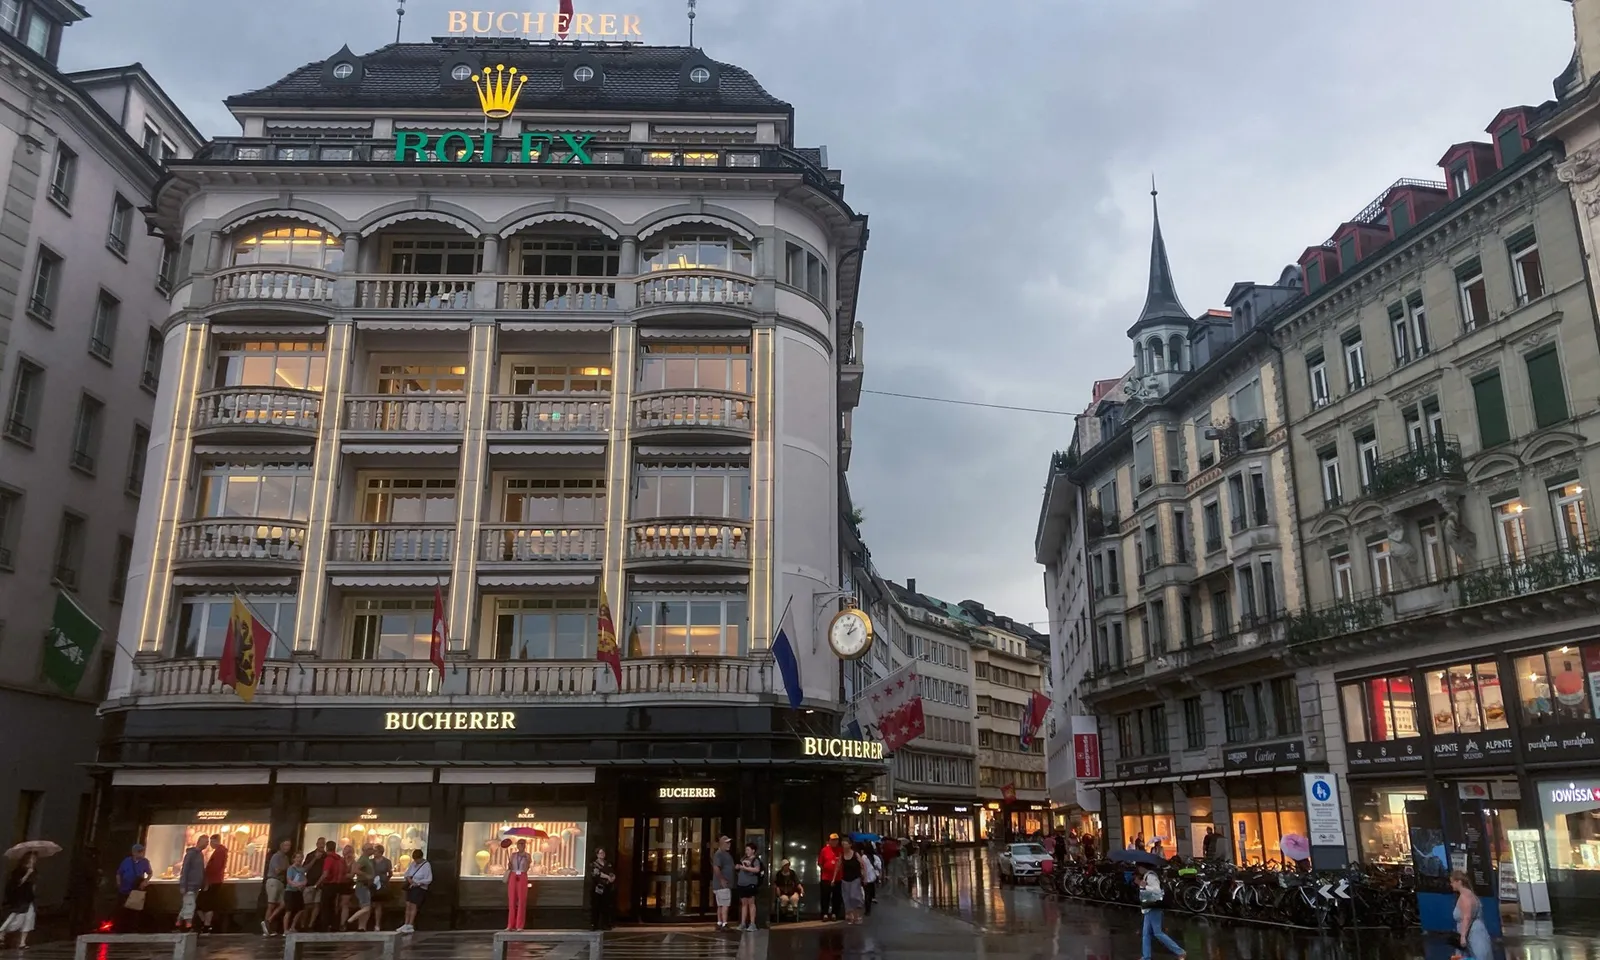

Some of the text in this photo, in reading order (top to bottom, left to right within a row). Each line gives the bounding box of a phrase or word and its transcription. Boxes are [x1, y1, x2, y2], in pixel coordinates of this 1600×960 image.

[448, 10, 641, 35] BUCHERER
[392, 131, 597, 164] ROLEX
[384, 711, 516, 730] BUCHERER
[804, 736, 883, 760] BUCHERER
[1528, 735, 1558, 752] puralpina
[1563, 731, 1594, 749] puralpina
[1255, 748, 1277, 762] Cartier
[659, 787, 716, 798] BUCHERER
